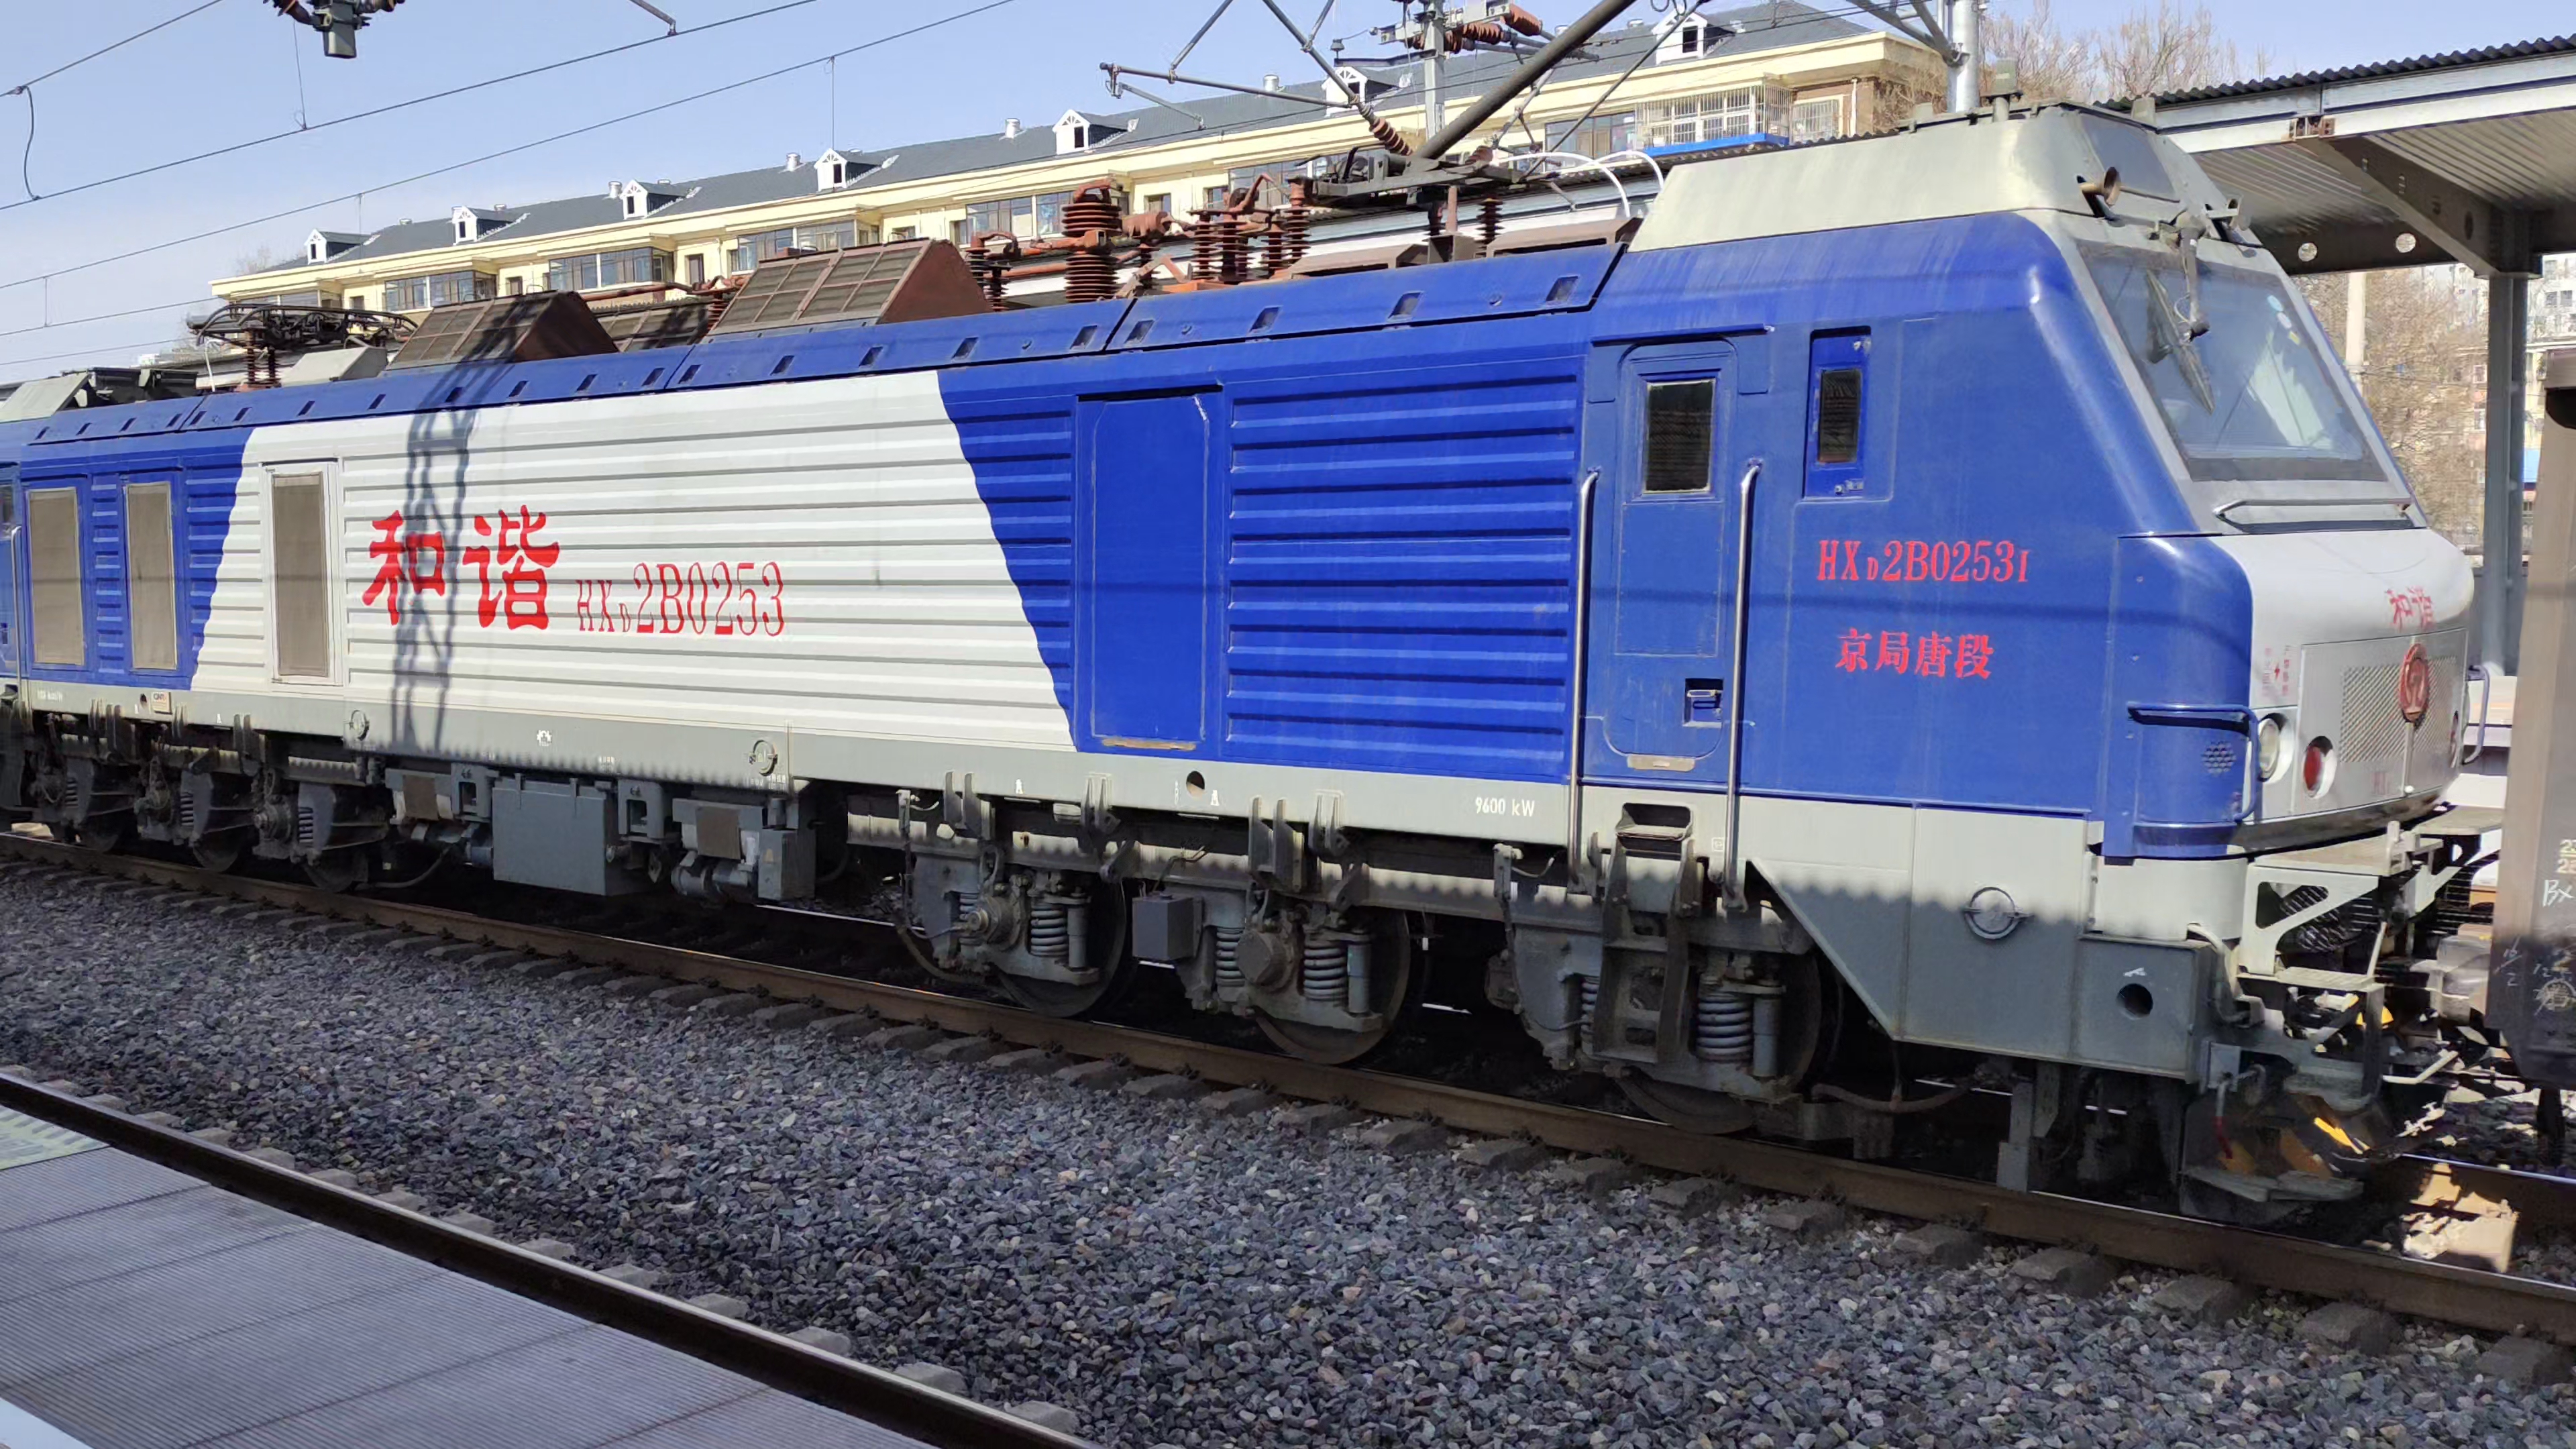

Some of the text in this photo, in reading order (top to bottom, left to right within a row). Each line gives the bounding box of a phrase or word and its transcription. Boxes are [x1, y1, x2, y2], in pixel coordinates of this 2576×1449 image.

[363, 504, 561, 631] 和谐
[1835, 627, 1994, 680] 京局唐段
[1475, 796, 1535, 816] 9600 kW
